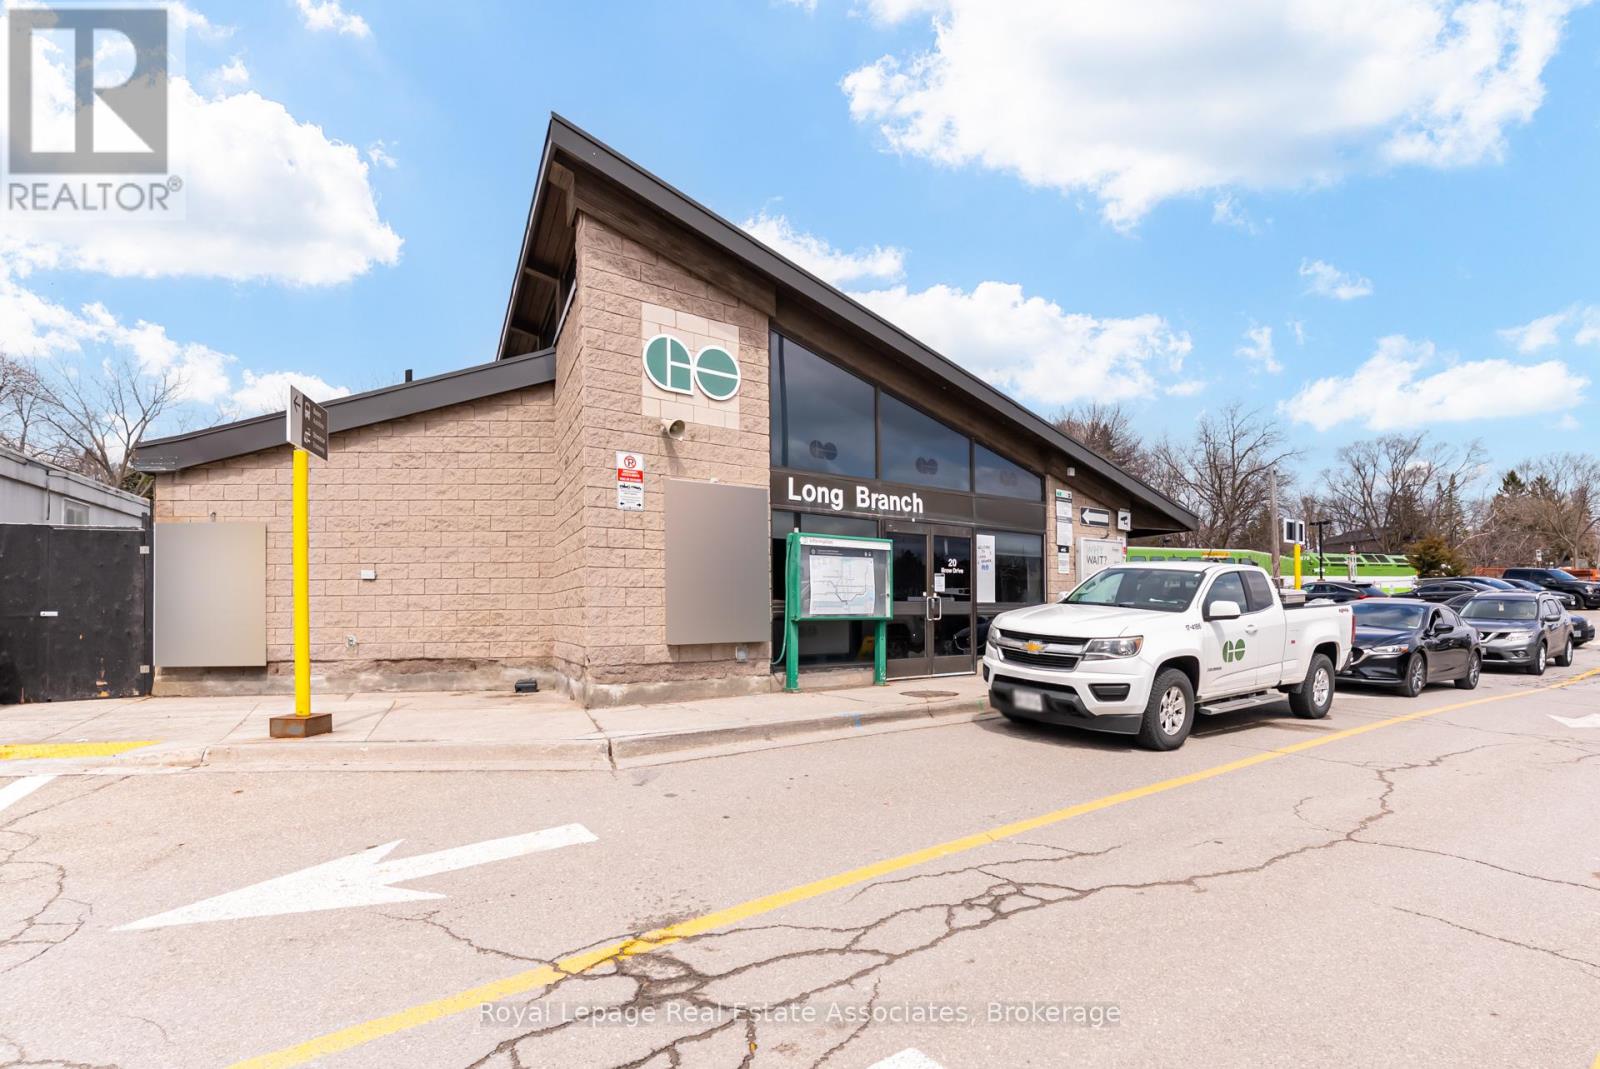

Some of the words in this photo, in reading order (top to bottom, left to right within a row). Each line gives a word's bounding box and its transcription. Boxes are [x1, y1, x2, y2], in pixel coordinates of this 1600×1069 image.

[788, 477, 844, 511] Long
[856, 486, 924, 514] Branch
[948, 558, 957, 567] 20
[1087, 555, 1107, 565] WAIT?
